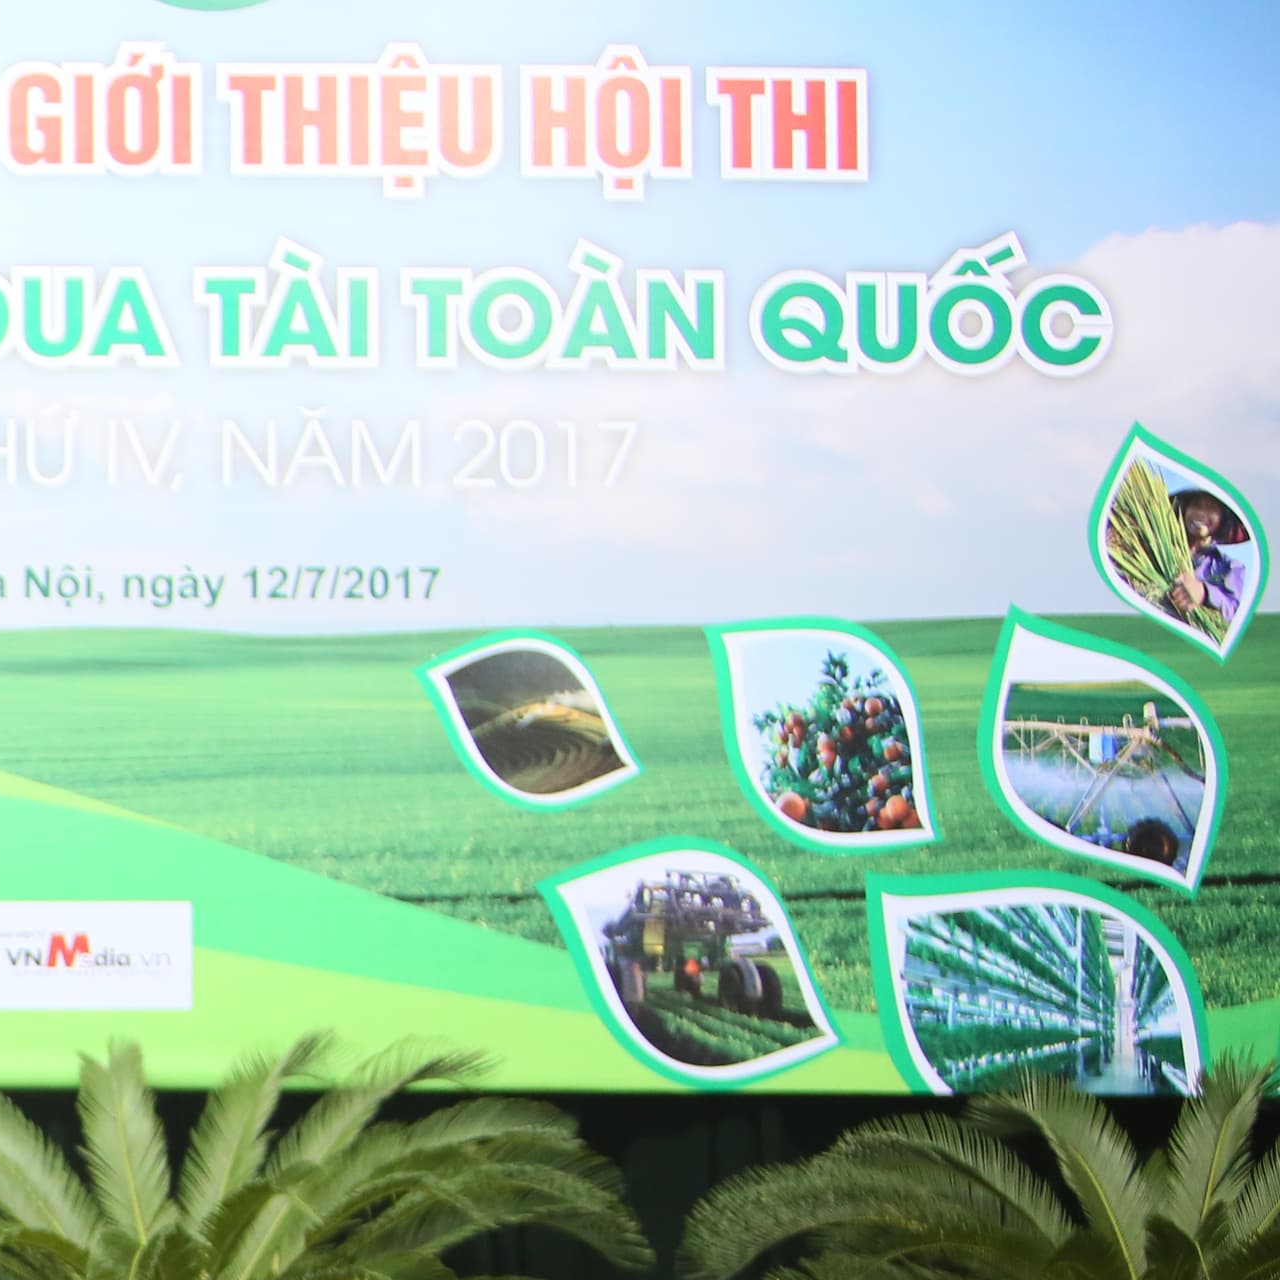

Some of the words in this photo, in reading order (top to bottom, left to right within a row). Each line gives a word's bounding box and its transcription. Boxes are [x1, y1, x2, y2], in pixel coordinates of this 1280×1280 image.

[8, 52, 194, 169] GIỚI
[226, 54, 495, 190] THIỆU
[530, 54, 684, 191] HỘI
[715, 77, 861, 172] THI
[201, 249, 372, 361] TÀI
[409, 249, 717, 363] TOÀN
[759, 243, 1104, 367] QUỐC
[221, 406, 425, 489] NĂM
[451, 418, 640, 489] 2017
[24, 564, 106, 607] Nội,
[122, 564, 226, 608] ngày
[242, 564, 443, 601] 12/7/2017
